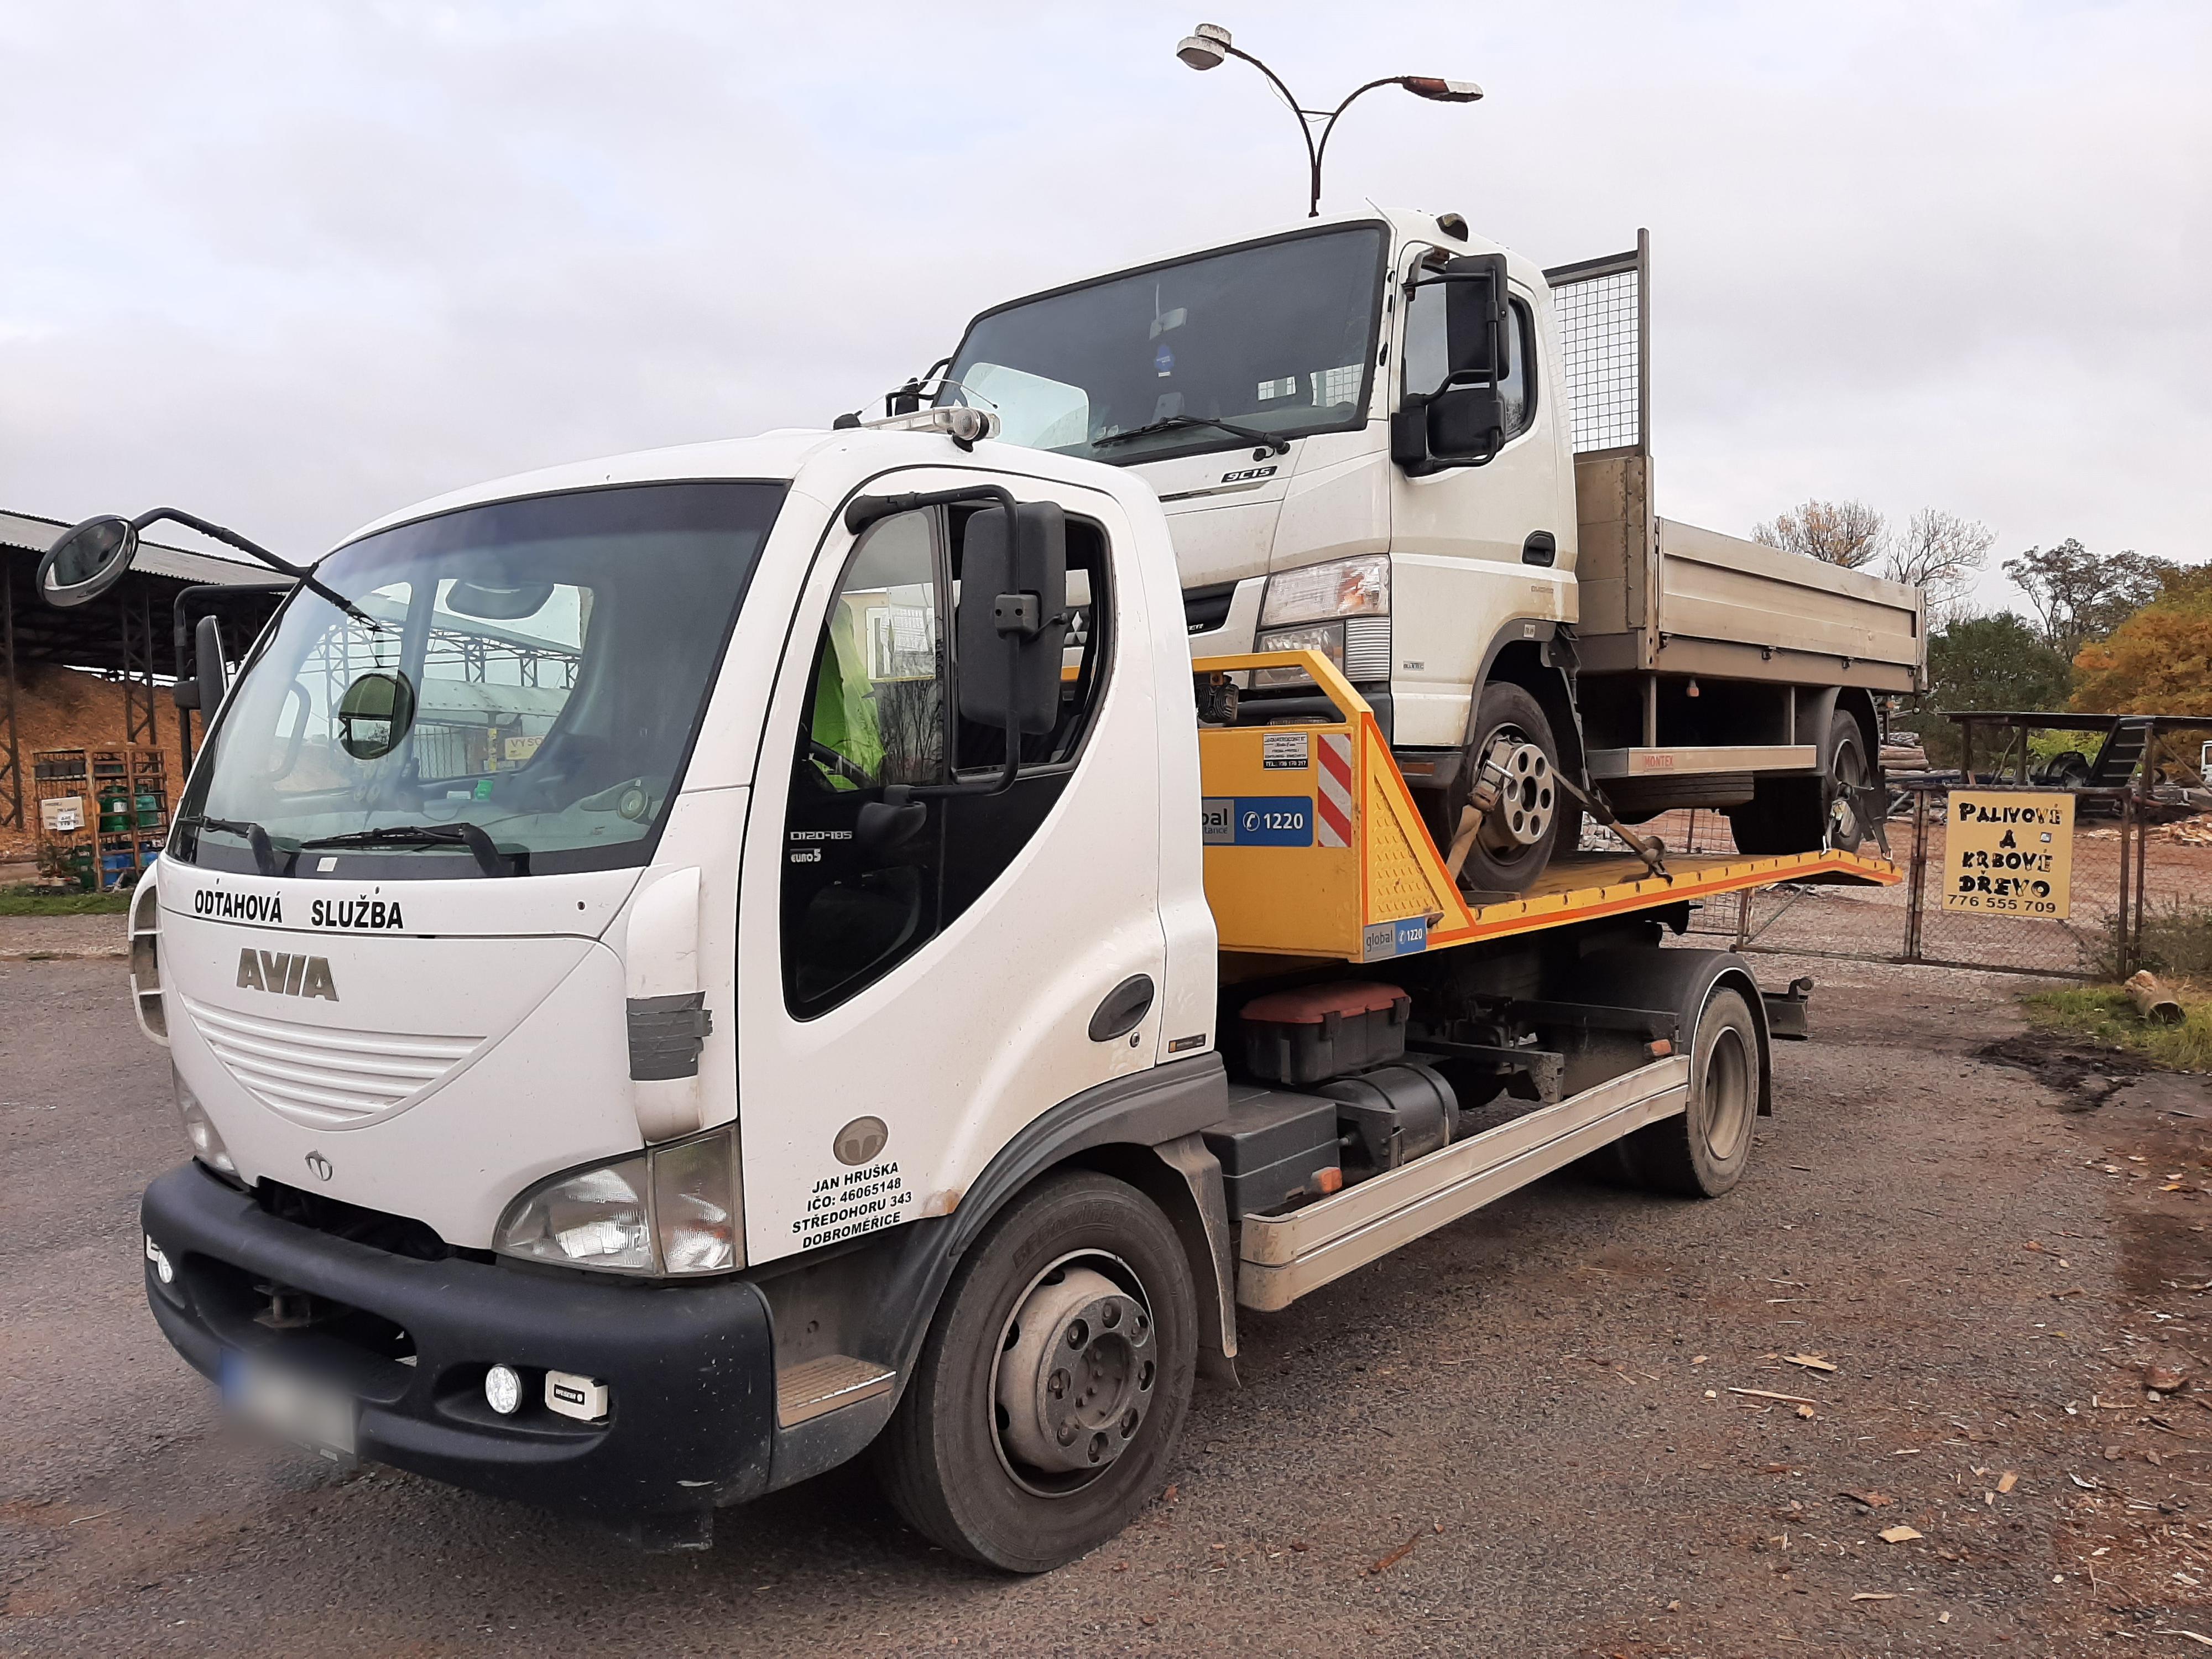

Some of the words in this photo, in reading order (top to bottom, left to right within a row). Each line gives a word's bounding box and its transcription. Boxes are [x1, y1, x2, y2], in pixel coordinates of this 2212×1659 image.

[1227, 468, 1271, 481] 9C15
[1645, 755, 1673, 768] MONTEX
[1264, 813, 1303, 829] 1220
[1999, 830, 2016, 848] A
[1962, 849, 2053, 873] KRBOVÉ
[1958, 870, 2051, 898] DŘEVO
[311, 894, 404, 929] SLUŽBA
[1948, 895, 1979, 906] 776
[1986, 898, 2017, 909] 555
[2024, 901, 2056, 913] 709
[1366, 928, 1393, 952] global
[1407, 928, 1422, 941] 1220
[236, 947, 340, 1002] AVIA
[812, 1176, 839, 1193] JAN
[844, 1161, 899, 1186] HRUŠKA
[807, 1195, 836, 1212] IČO:
[839, 1177, 901, 1203] 46065148
[890, 1191, 912, 1207] 343
